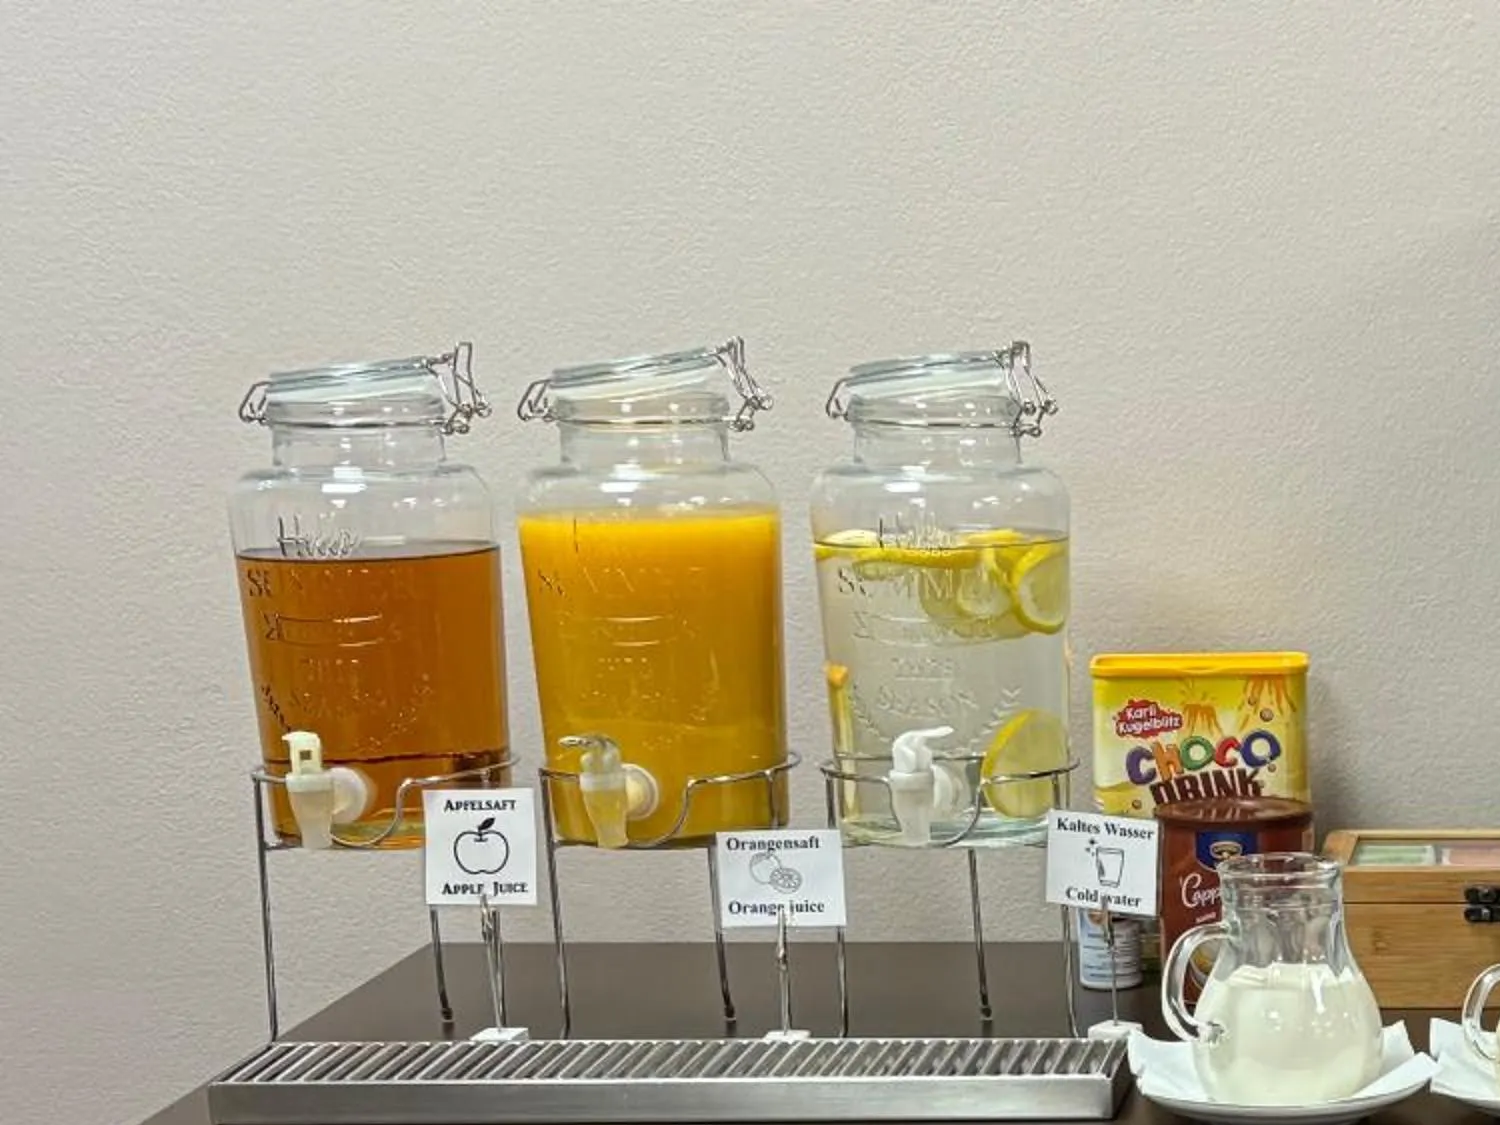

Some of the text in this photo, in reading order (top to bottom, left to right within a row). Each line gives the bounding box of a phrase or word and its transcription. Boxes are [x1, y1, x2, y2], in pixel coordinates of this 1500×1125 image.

[1126, 729, 1282, 785] CHOCO
[1150, 767, 1262, 804] DRINK
[1057, 817, 1154, 840] Kaltes Wasser
[726, 835, 820, 851] Orangensaft
[1065, 886, 1099, 903] Cold
[728, 899, 825, 916] Orange juice
